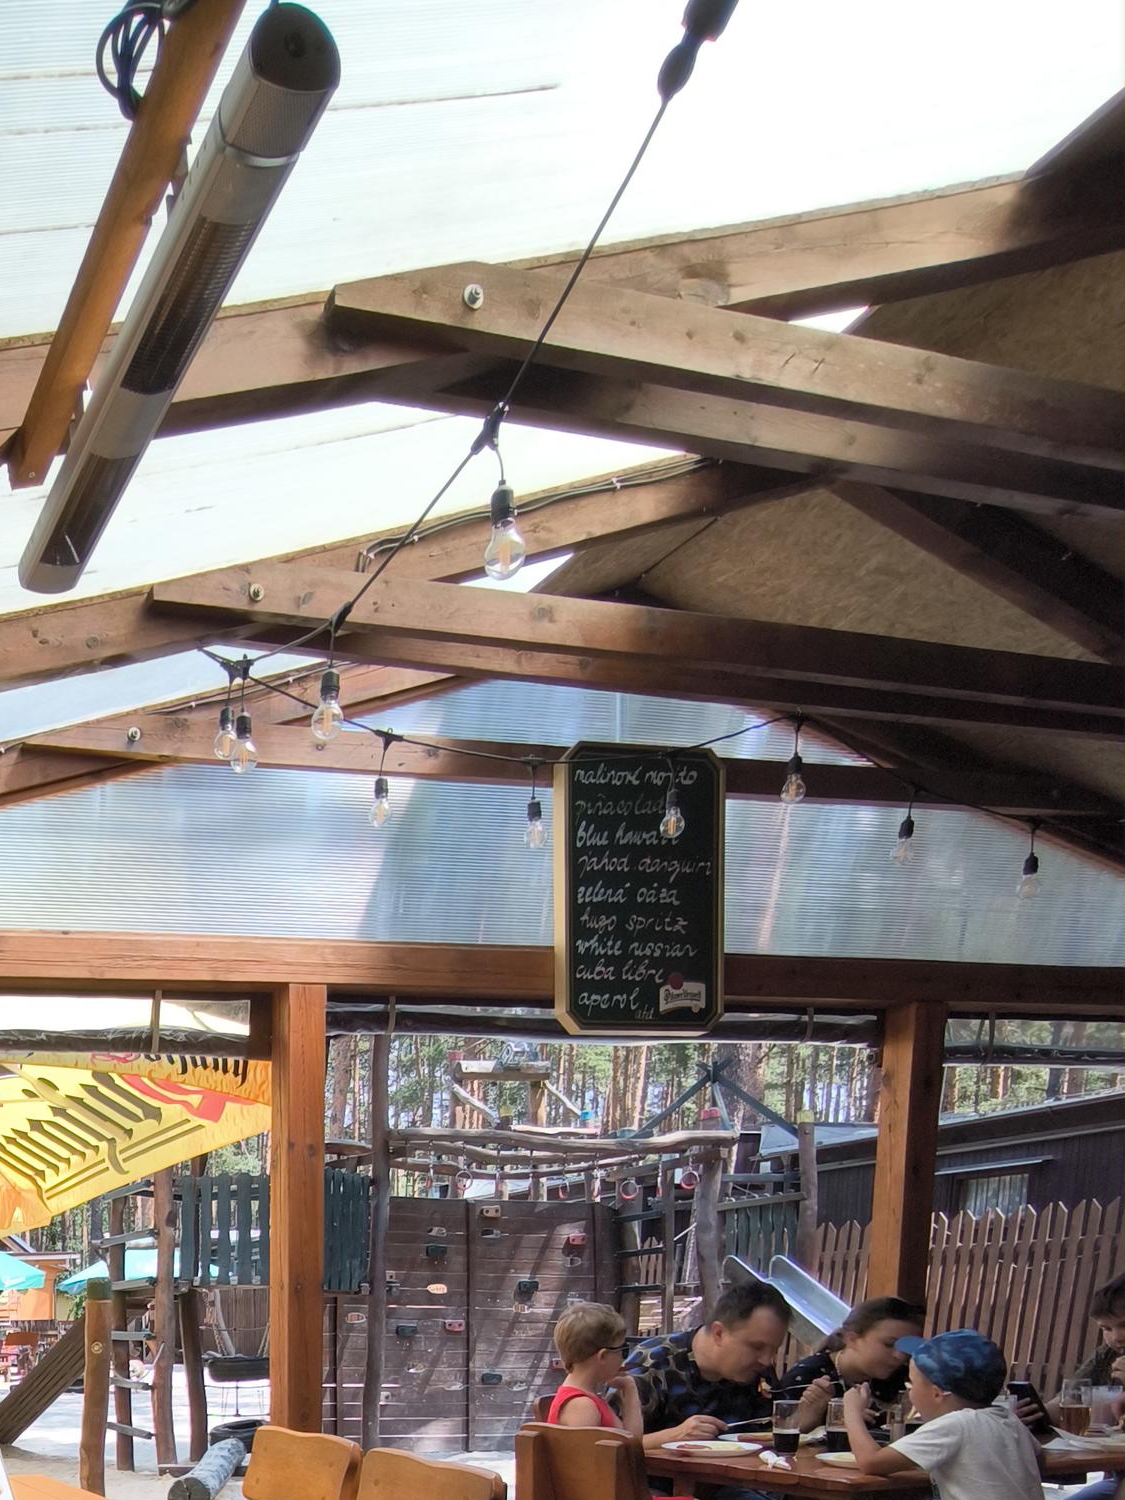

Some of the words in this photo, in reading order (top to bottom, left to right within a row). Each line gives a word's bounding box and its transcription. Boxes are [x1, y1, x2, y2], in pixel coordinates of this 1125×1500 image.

[576, 820, 610, 848] blue
[577, 880, 631, 904] zelená
[636, 882, 680, 906] oáza
[579, 907, 617, 934] hugo
[625, 911, 689, 937] spritz
[575, 931, 622, 956] white
[628, 941, 698, 957] russian
[576, 959, 616, 980] cuba
[622, 959, 665, 983] libre
[578, 987, 640, 1016] aperol
